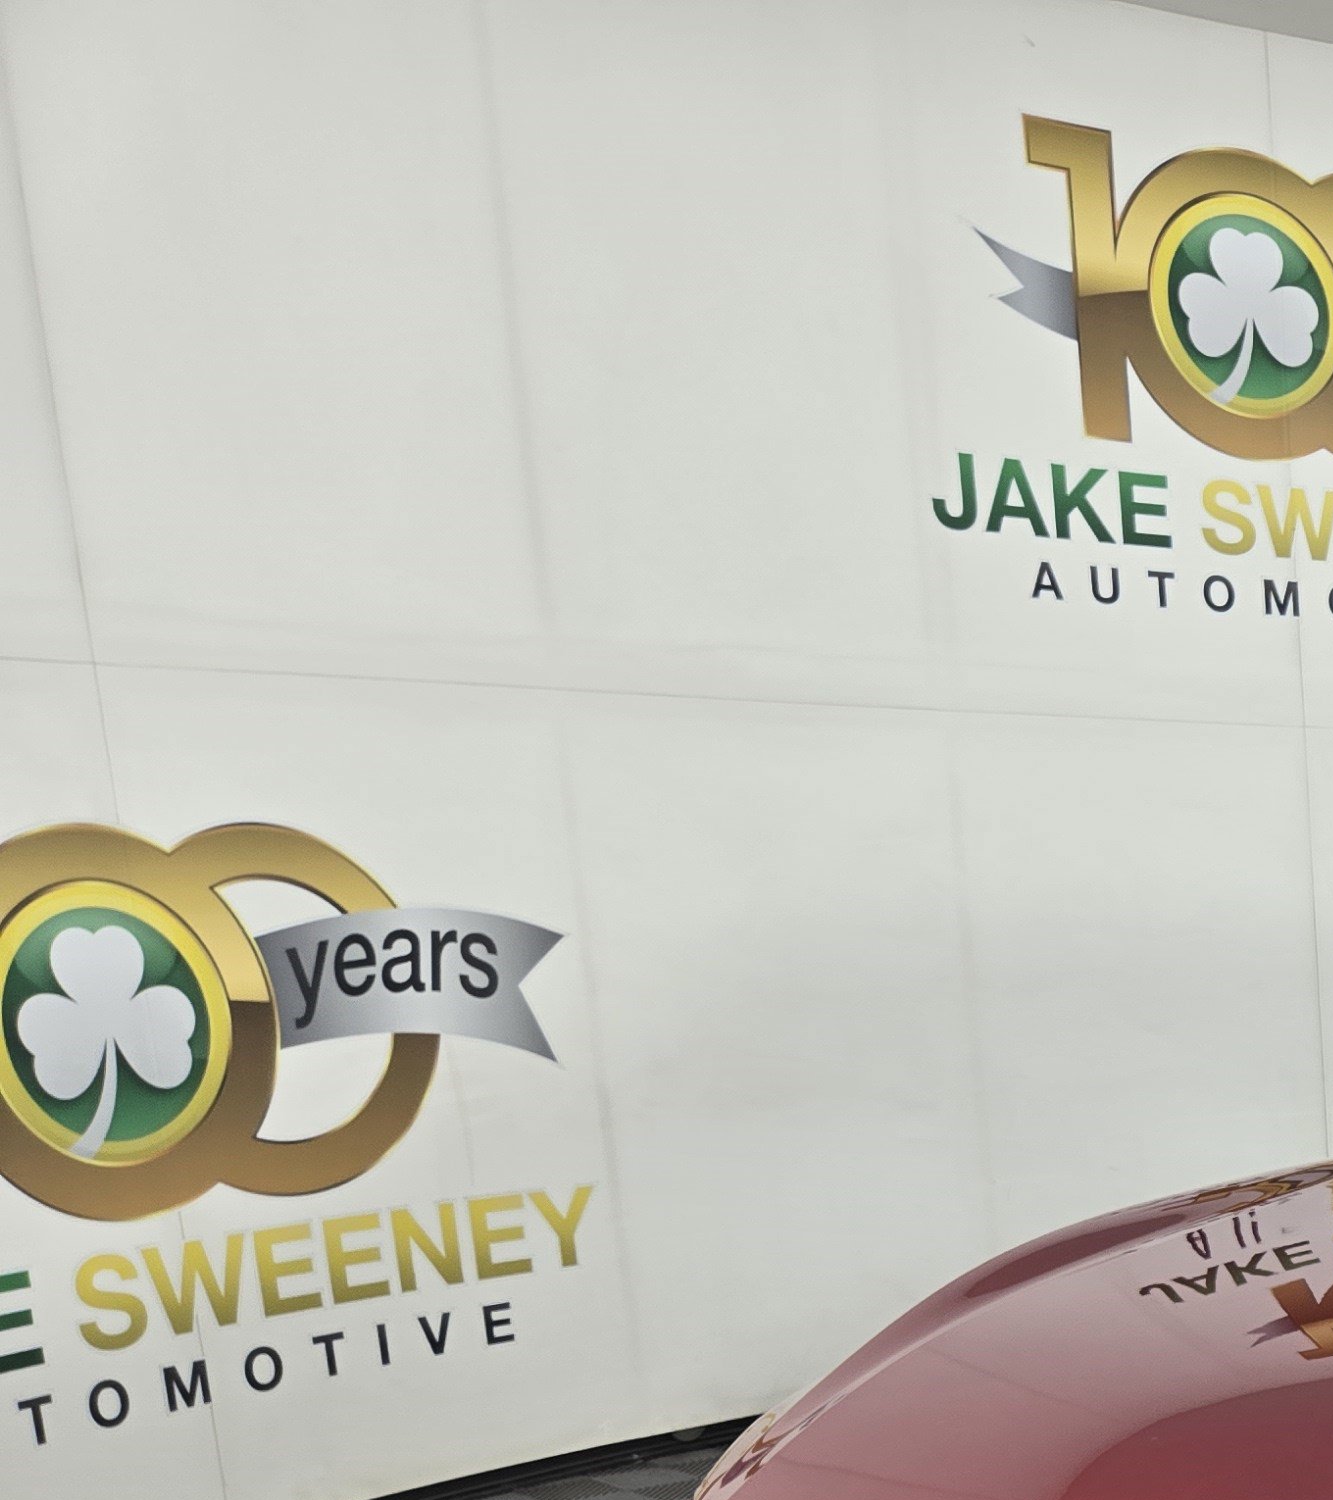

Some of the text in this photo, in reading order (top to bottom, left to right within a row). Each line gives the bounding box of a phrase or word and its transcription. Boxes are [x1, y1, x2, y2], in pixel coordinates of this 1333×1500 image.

[931, 452, 1173, 548] JAKE
[286, 928, 499, 1030] years
[74, 1185, 594, 1351] SWEENEY
